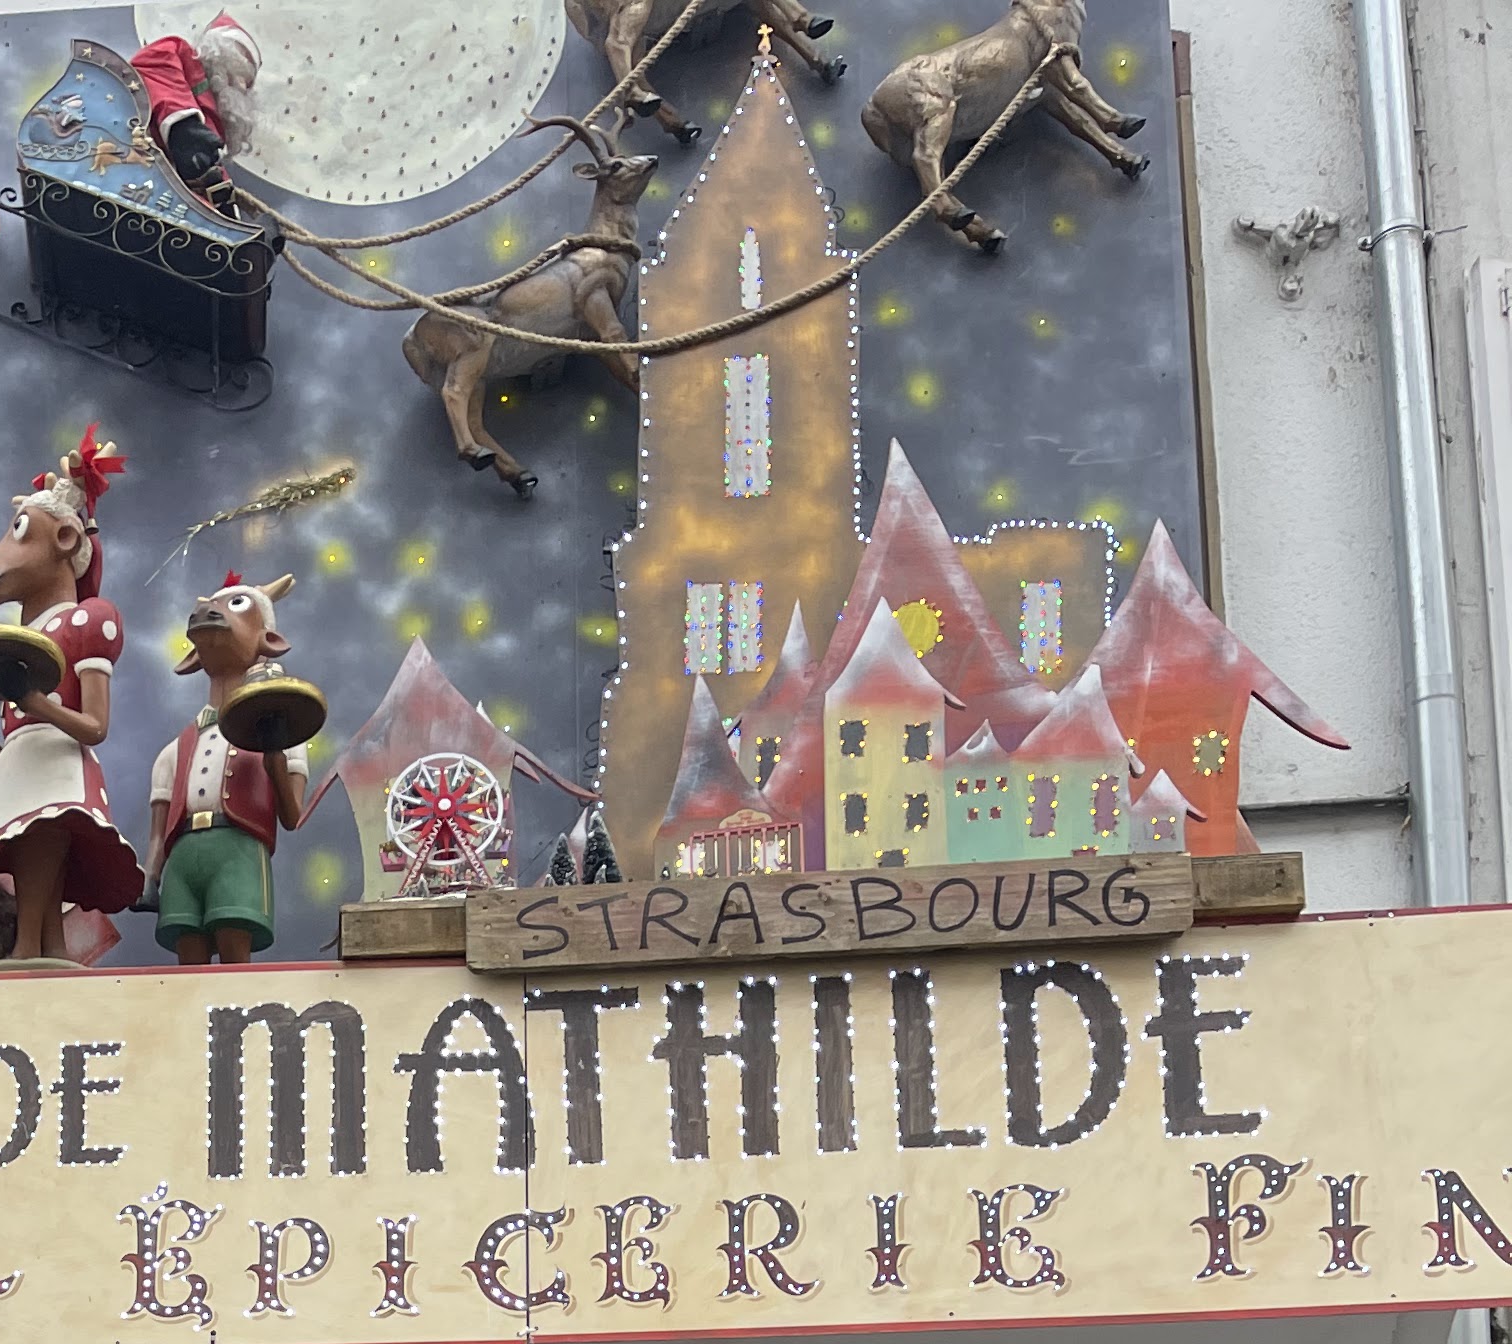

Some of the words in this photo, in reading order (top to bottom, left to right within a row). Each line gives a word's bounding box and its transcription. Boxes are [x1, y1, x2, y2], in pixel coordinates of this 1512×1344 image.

[517, 865, 1152, 960] STRASBOURG
[206, 952, 1269, 1181] MATHILDE
[117, 1180, 1068, 1332] ÉPICERIE
